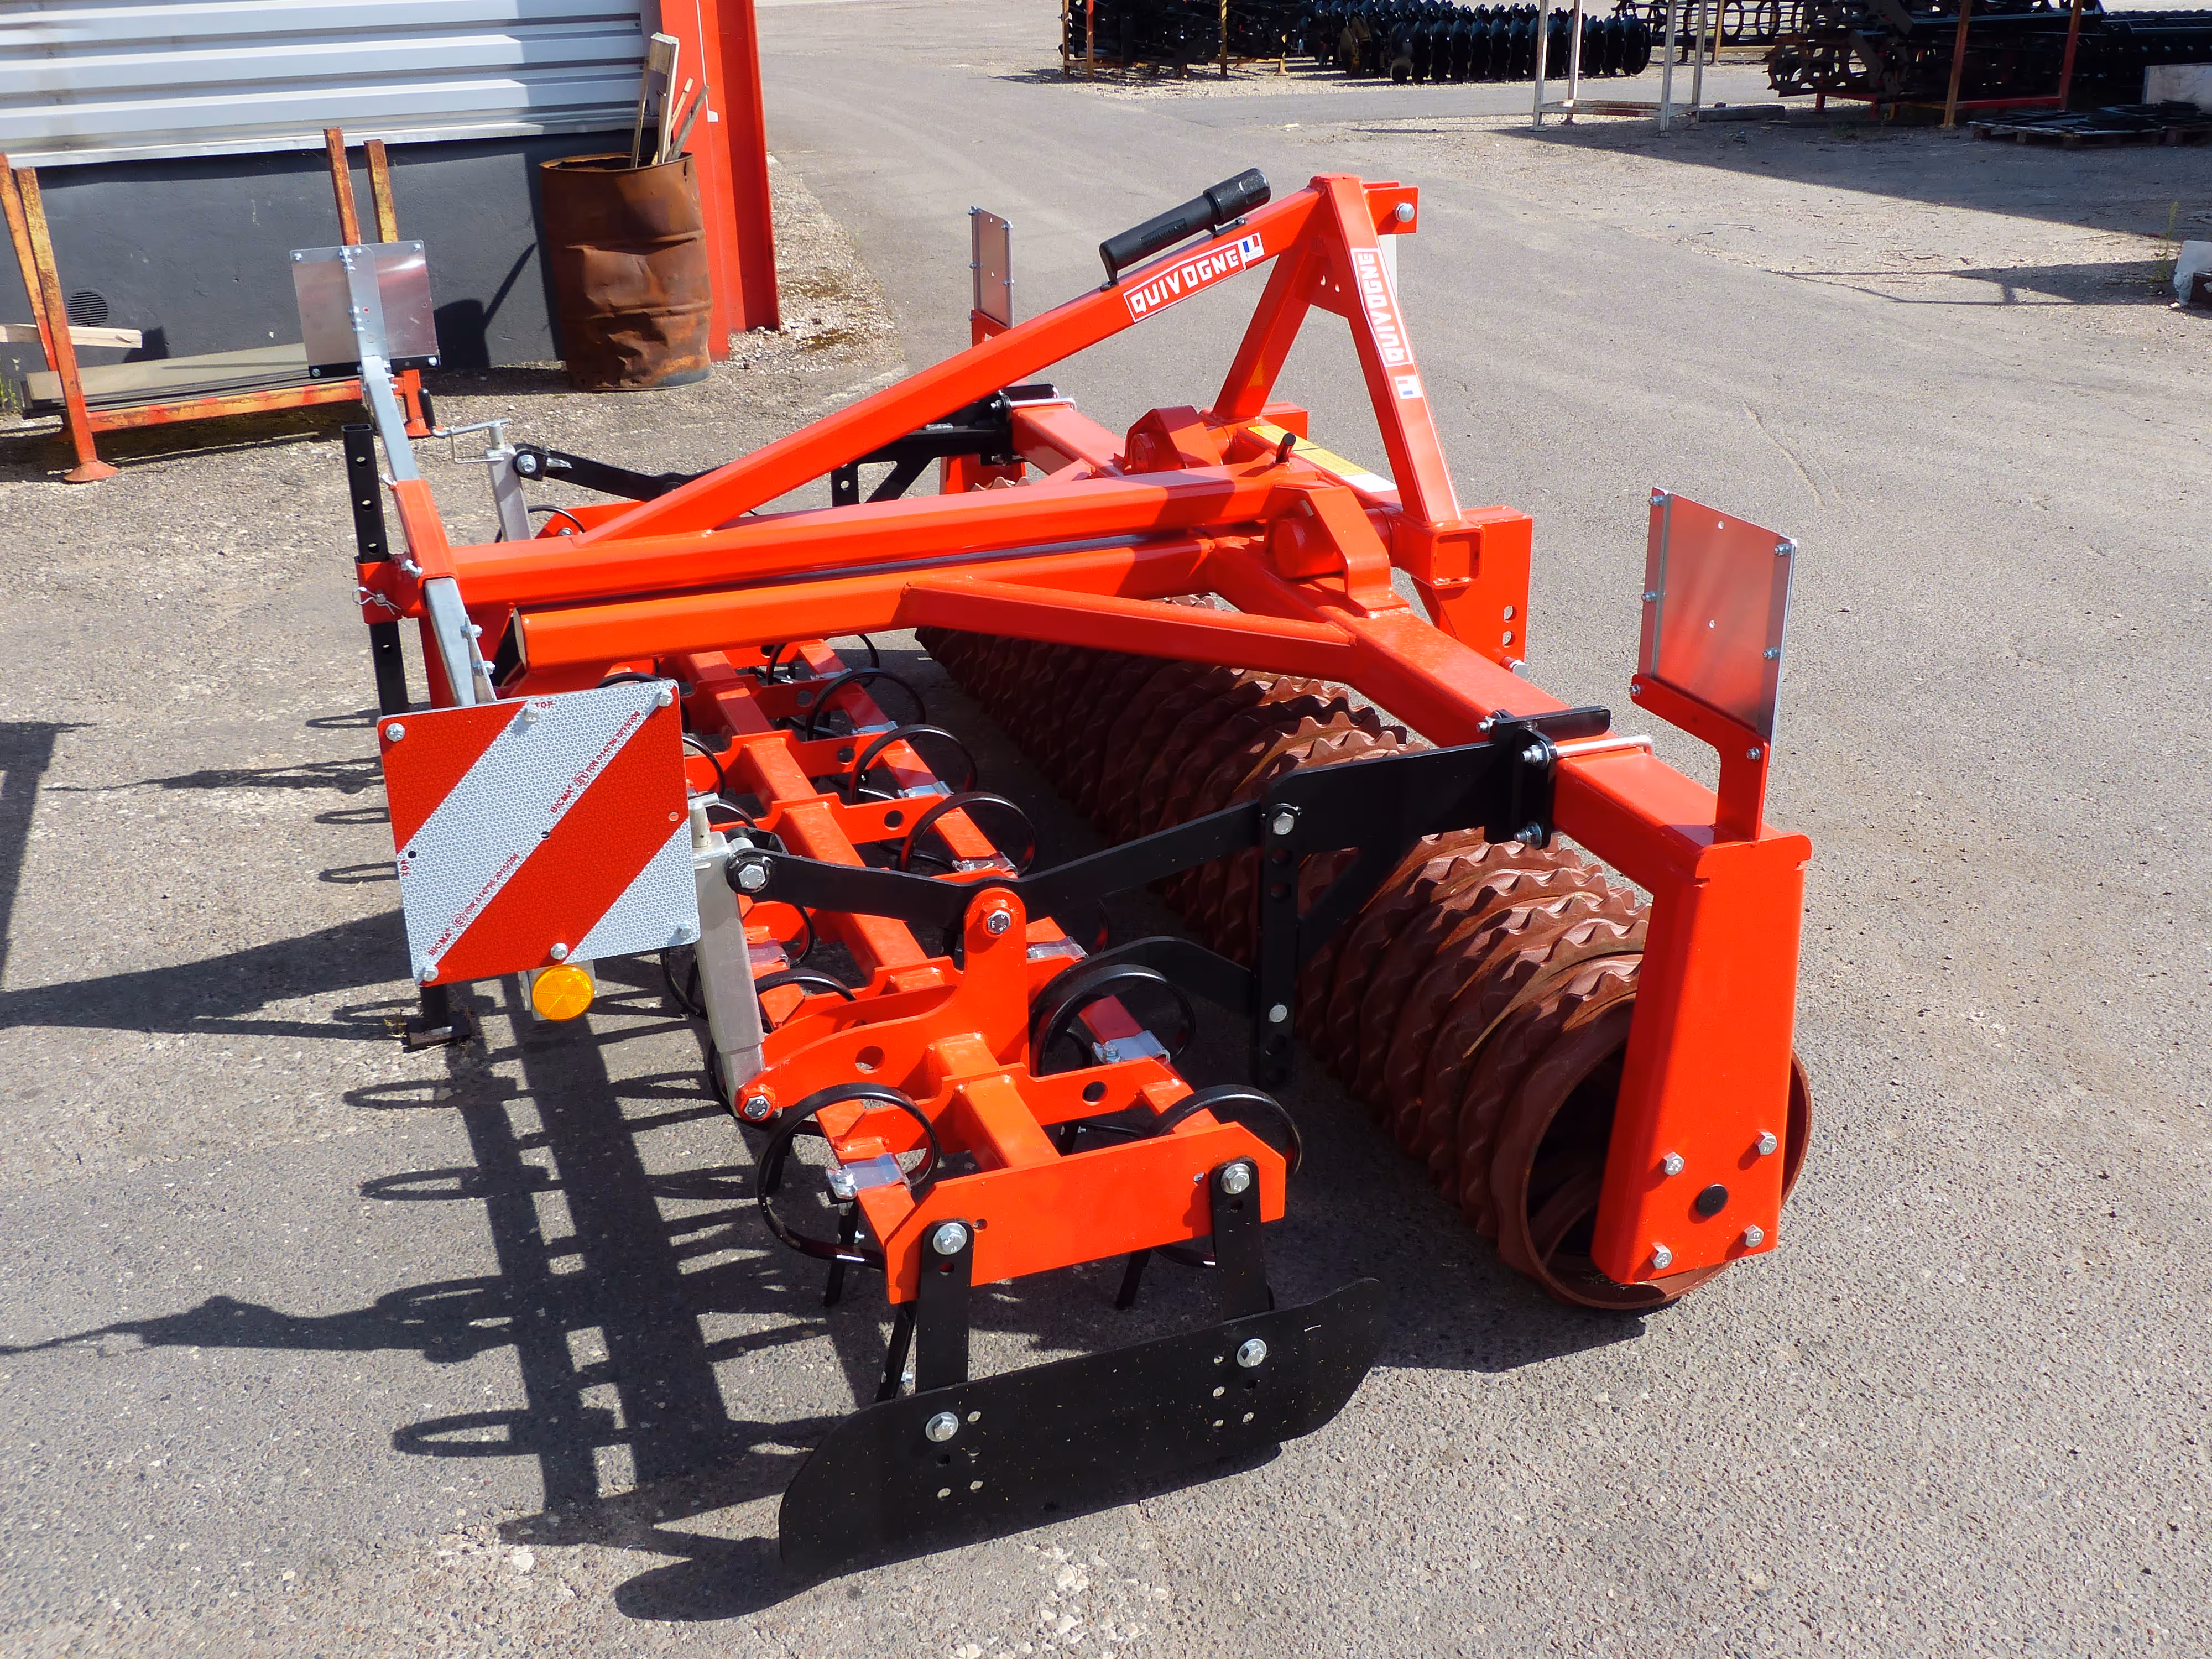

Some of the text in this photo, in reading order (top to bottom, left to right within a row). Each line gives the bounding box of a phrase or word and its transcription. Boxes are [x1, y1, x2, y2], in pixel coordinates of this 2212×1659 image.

[1130, 249, 1240, 313] QUIVOGNE
[1357, 253, 1405, 362] QUIVOGNE
[400, 859, 409, 876] TOP
